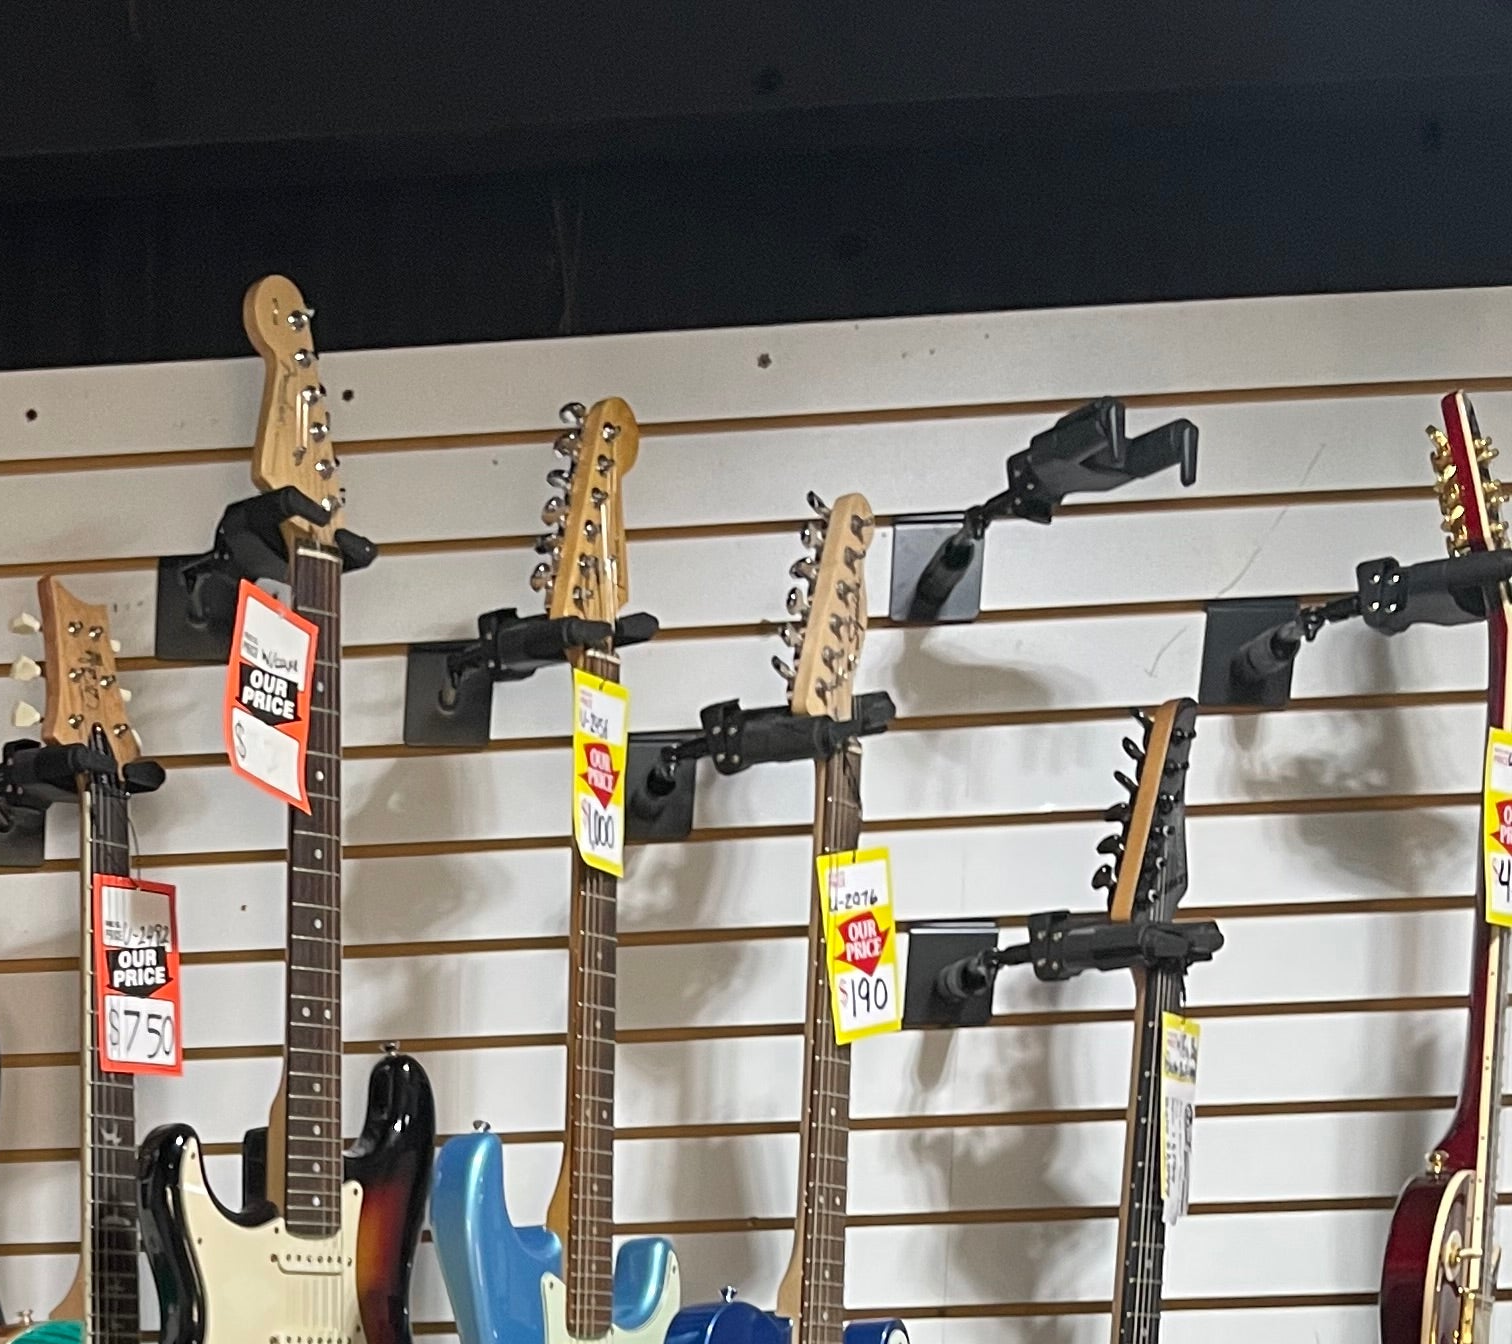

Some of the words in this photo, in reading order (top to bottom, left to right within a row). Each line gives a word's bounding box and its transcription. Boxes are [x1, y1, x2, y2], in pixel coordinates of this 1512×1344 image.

[250, 669, 288, 699] OUR
[242, 685, 295, 720] PRICE
[848, 919, 877, 941] OUR
[118, 951, 157, 970] OUR
[845, 937, 882, 963] PRICE
[113, 968, 166, 988] PRICE
[839, 977, 888, 1018] $190
[109, 1009, 174, 1059] $750
